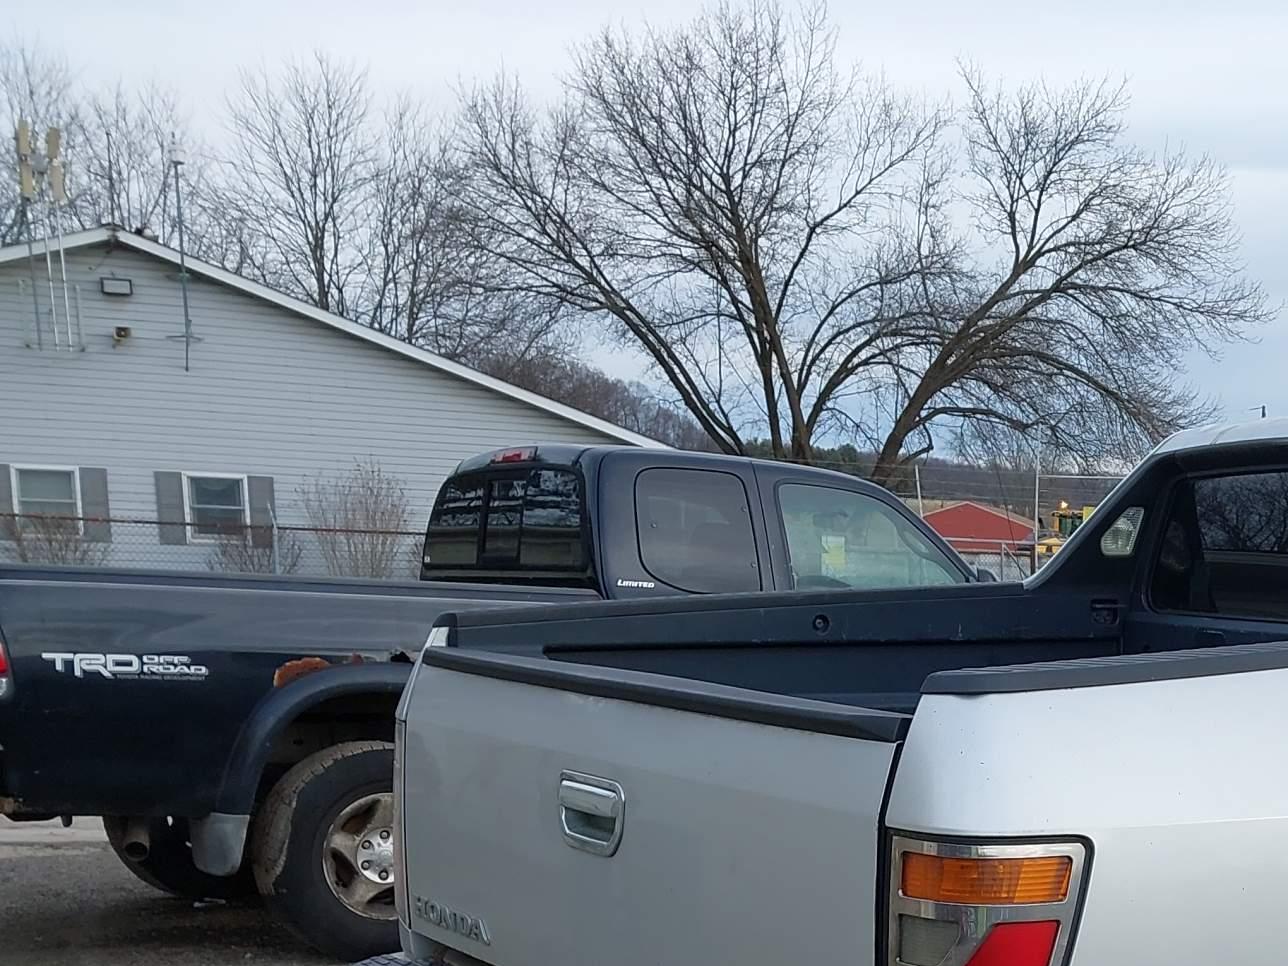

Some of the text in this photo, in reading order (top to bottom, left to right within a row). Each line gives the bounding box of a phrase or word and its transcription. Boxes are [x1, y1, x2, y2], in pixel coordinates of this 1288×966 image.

[41, 652, 141, 679] TRD
[142, 655, 191, 664] OFF
[142, 665, 208, 676] ROAD
[415, 896, 490, 946] HONDA
